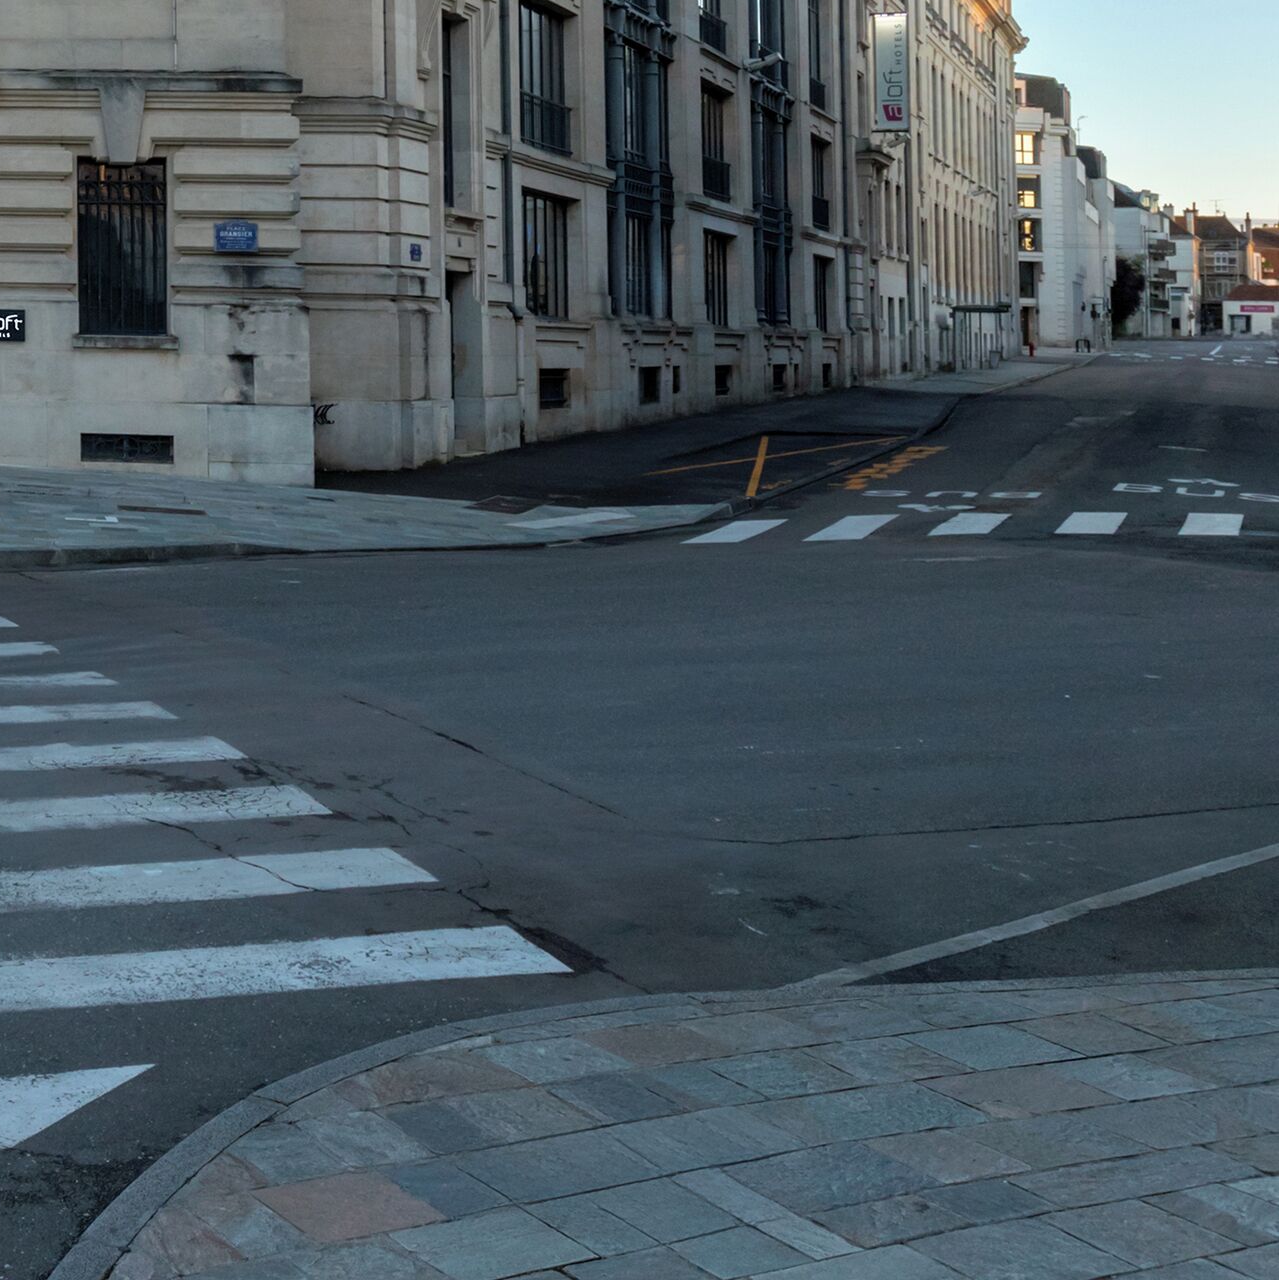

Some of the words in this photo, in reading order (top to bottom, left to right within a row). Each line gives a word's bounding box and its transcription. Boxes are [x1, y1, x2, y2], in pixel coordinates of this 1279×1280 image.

[882, 70, 903, 121] aloft
[894, 23, 903, 65] HOTELS
[1112, 483, 1279, 502] BUS
